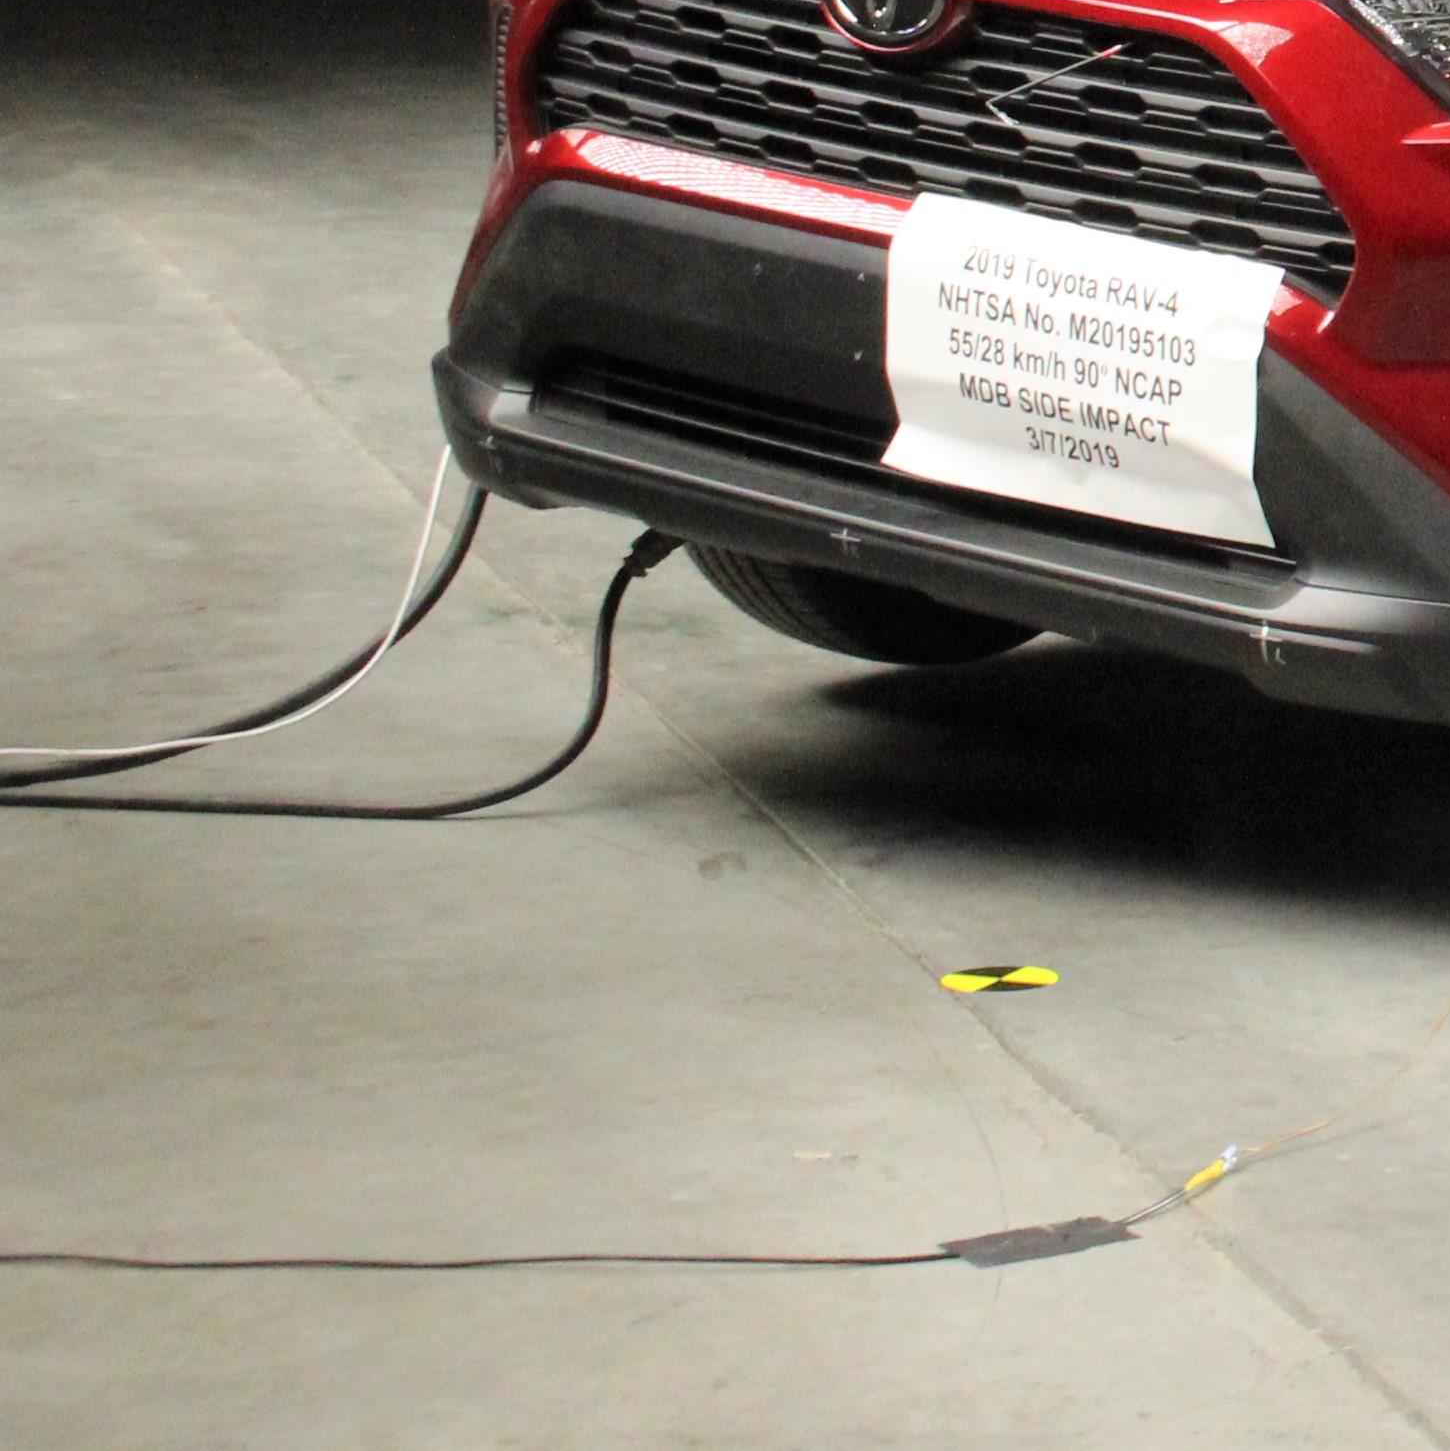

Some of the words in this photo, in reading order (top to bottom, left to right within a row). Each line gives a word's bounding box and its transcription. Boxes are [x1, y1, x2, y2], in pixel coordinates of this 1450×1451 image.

[963, 245, 1015, 281] 2019
[1023, 257, 1098, 301] Toyota
[1106, 277, 1179, 318] RAV-4
[938, 281, 1016, 327] NHTSA
[1024, 300, 1060, 337] No.
[1069, 312, 1196, 367] M20195103
[949, 328, 1005, 366] 55/28
[1013, 342, 1066, 381] km/h
[1115, 370, 1183, 407] NCAP
[959, 372, 1011, 409] MDB
[1019, 388, 1073, 424] SIDE
[1080, 401, 1171, 447] IMPACT
[1025, 426, 1120, 470] 3/7/2019
